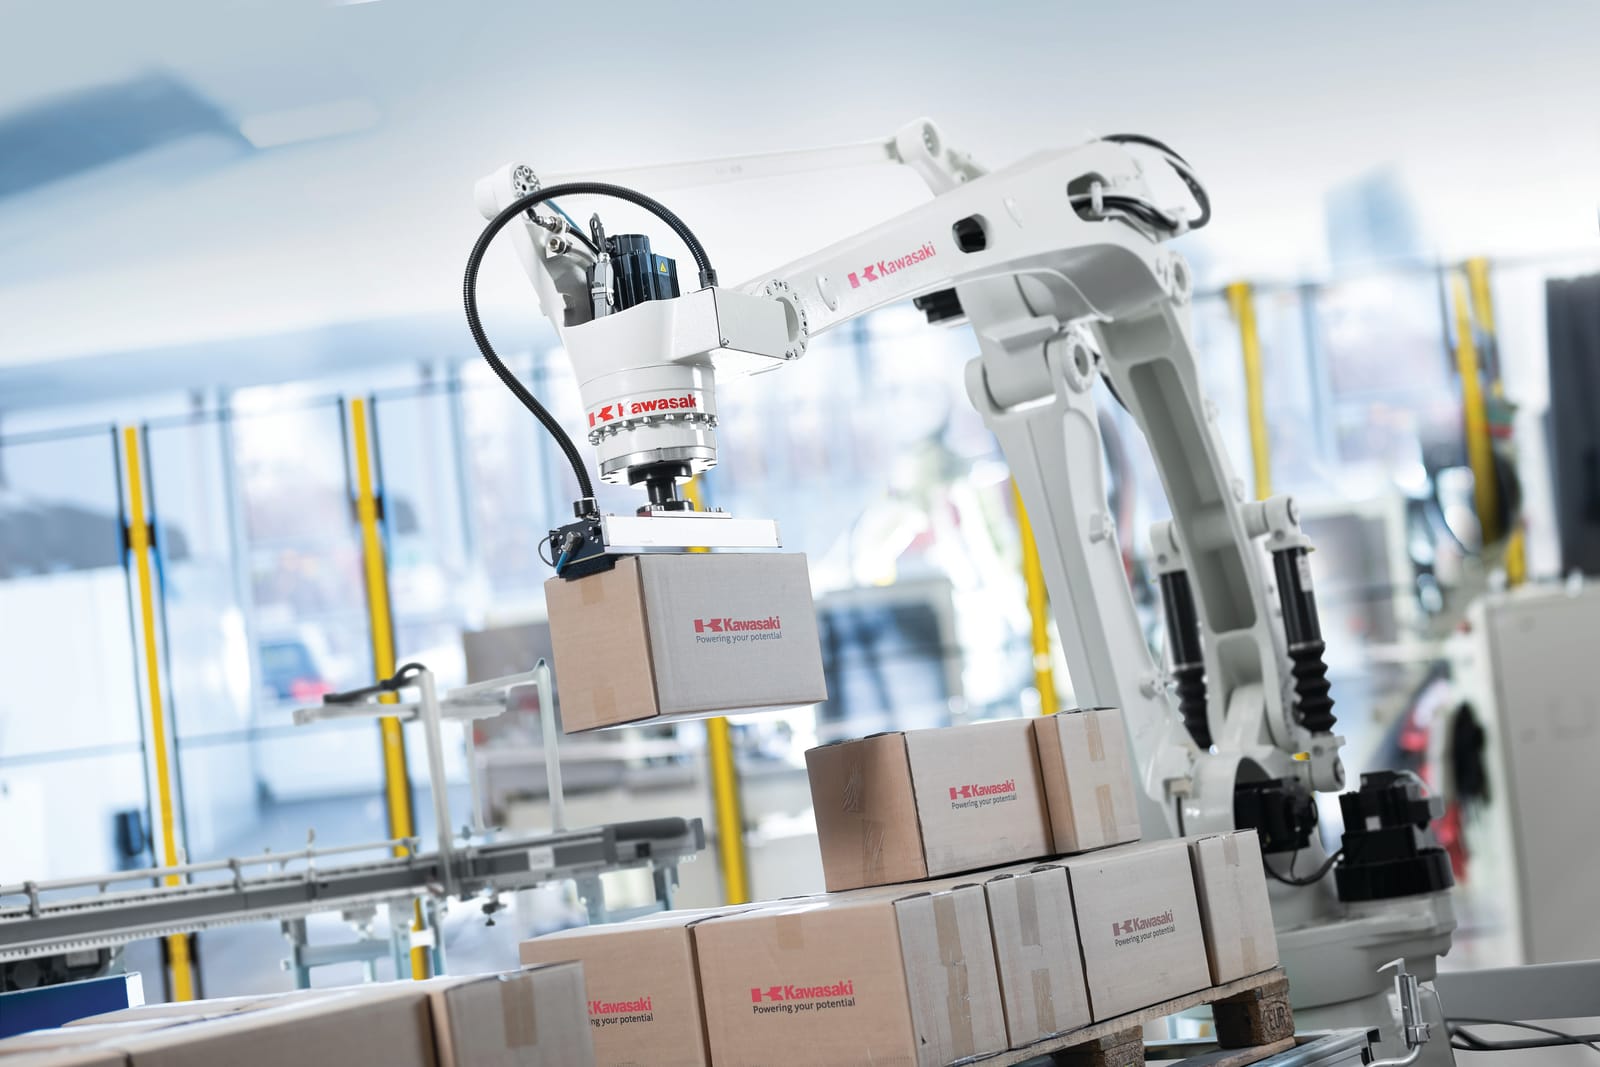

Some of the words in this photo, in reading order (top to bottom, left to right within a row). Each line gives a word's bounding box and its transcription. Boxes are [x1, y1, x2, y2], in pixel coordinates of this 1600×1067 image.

[877, 241, 937, 277] Kawasaki
[723, 616, 781, 632] Kawasaki
[696, 634, 731, 645] Powering
[732, 634, 749, 644] your
[750, 631, 782, 643] potential
[971, 779, 1016, 797] Kawasaki
[951, 800, 979, 810] Powering
[979, 798, 992, 808] your
[993, 793, 1017, 806] potential
[1132, 909, 1174, 932] Kawasaki
[1114, 934, 1140, 947] Powering
[1140, 932, 1153, 943] your
[1152, 924, 1176, 939] potential
[784, 980, 854, 1000] Kawasaki
[593, 996, 652, 1015] Kawasaki
[753, 1003, 793, 1014] Powering
[794, 1002, 814, 1013] your
[816, 997, 856, 1011] potential
[601, 1016, 618, 1027] your
[620, 1013, 654, 1026] potential
